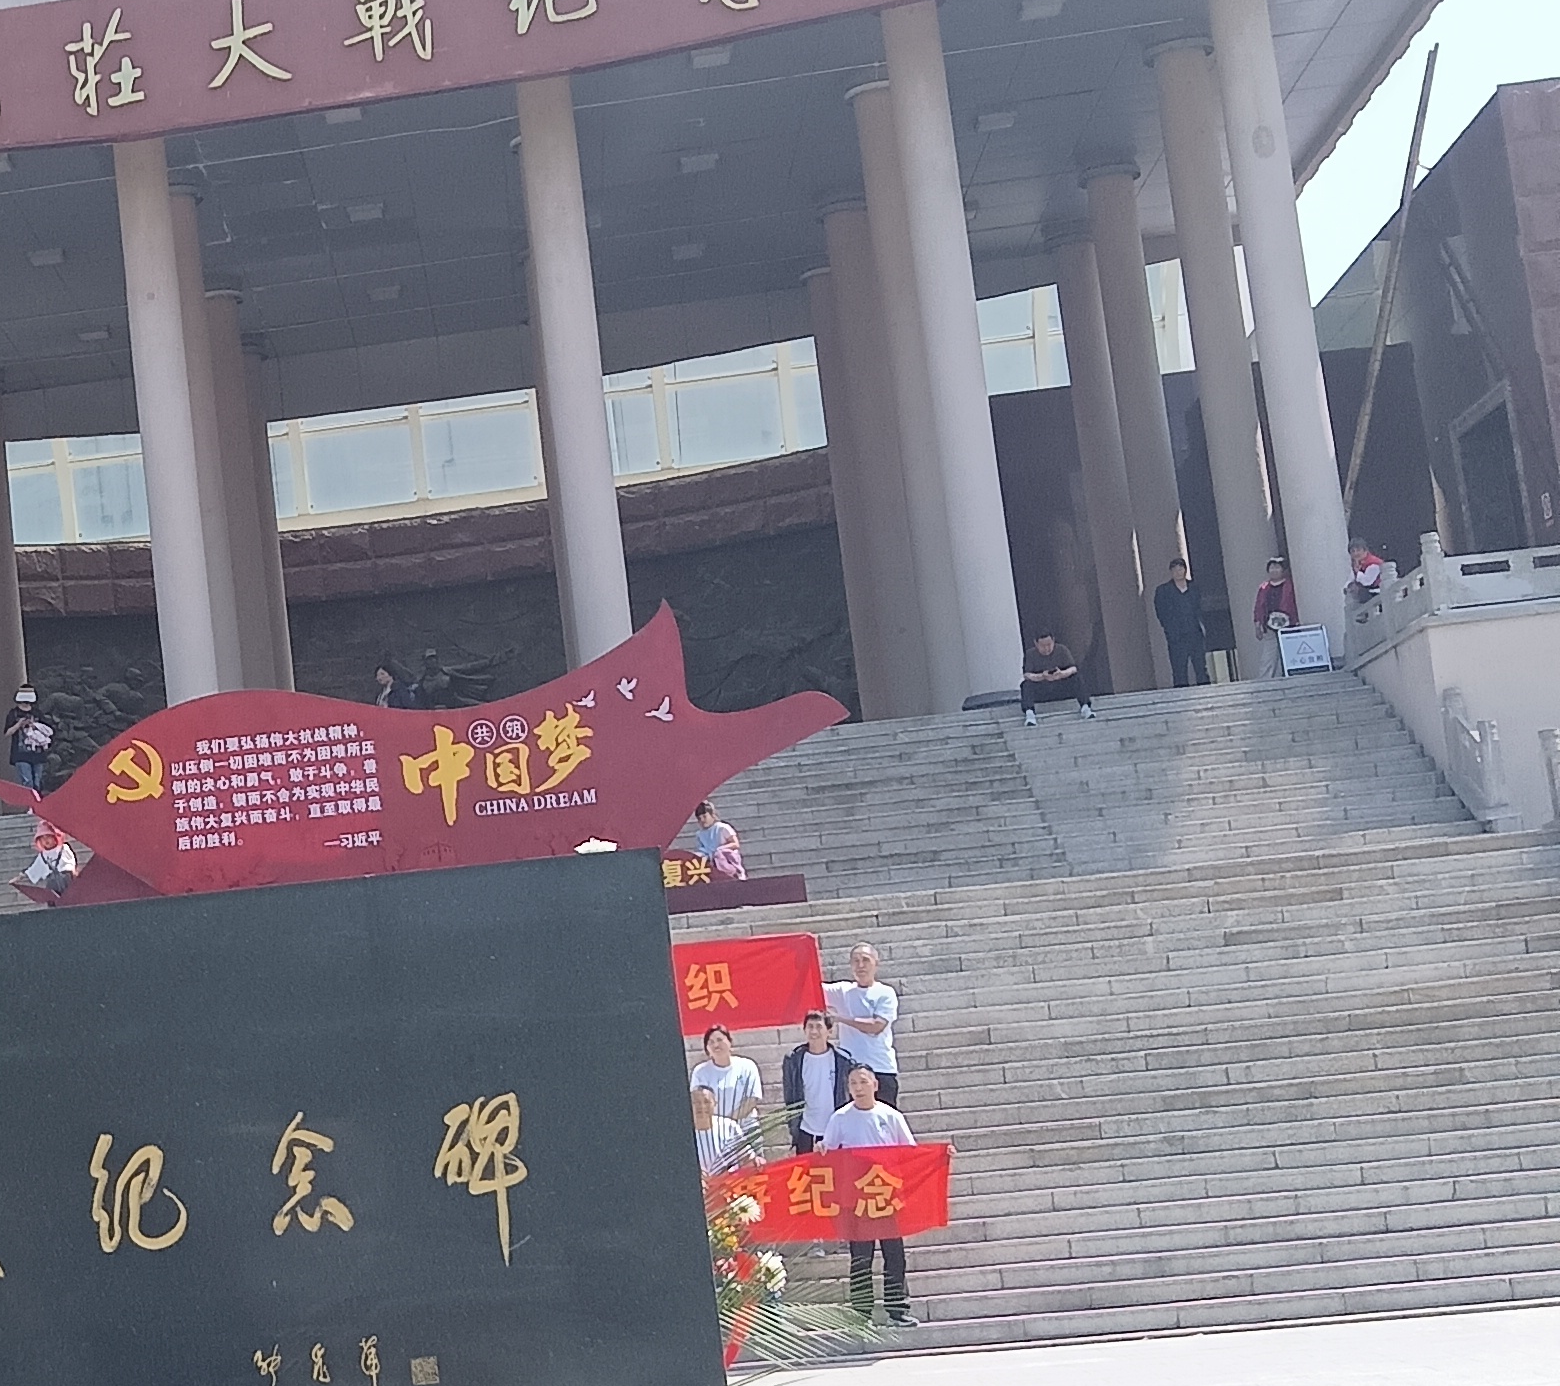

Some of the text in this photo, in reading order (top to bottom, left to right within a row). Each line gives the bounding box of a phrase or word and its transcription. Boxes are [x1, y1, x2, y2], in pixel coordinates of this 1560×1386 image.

[472, 719, 526, 745] 共筑
[170, 740, 376, 777] 以压倒一切困难而不为困难所压
[399, 702, 594, 826] 中国梦
[475, 788, 597, 817] CHINA DREAM
[661, 856, 712, 888] 复兴
[684, 962, 739, 1012] 织
